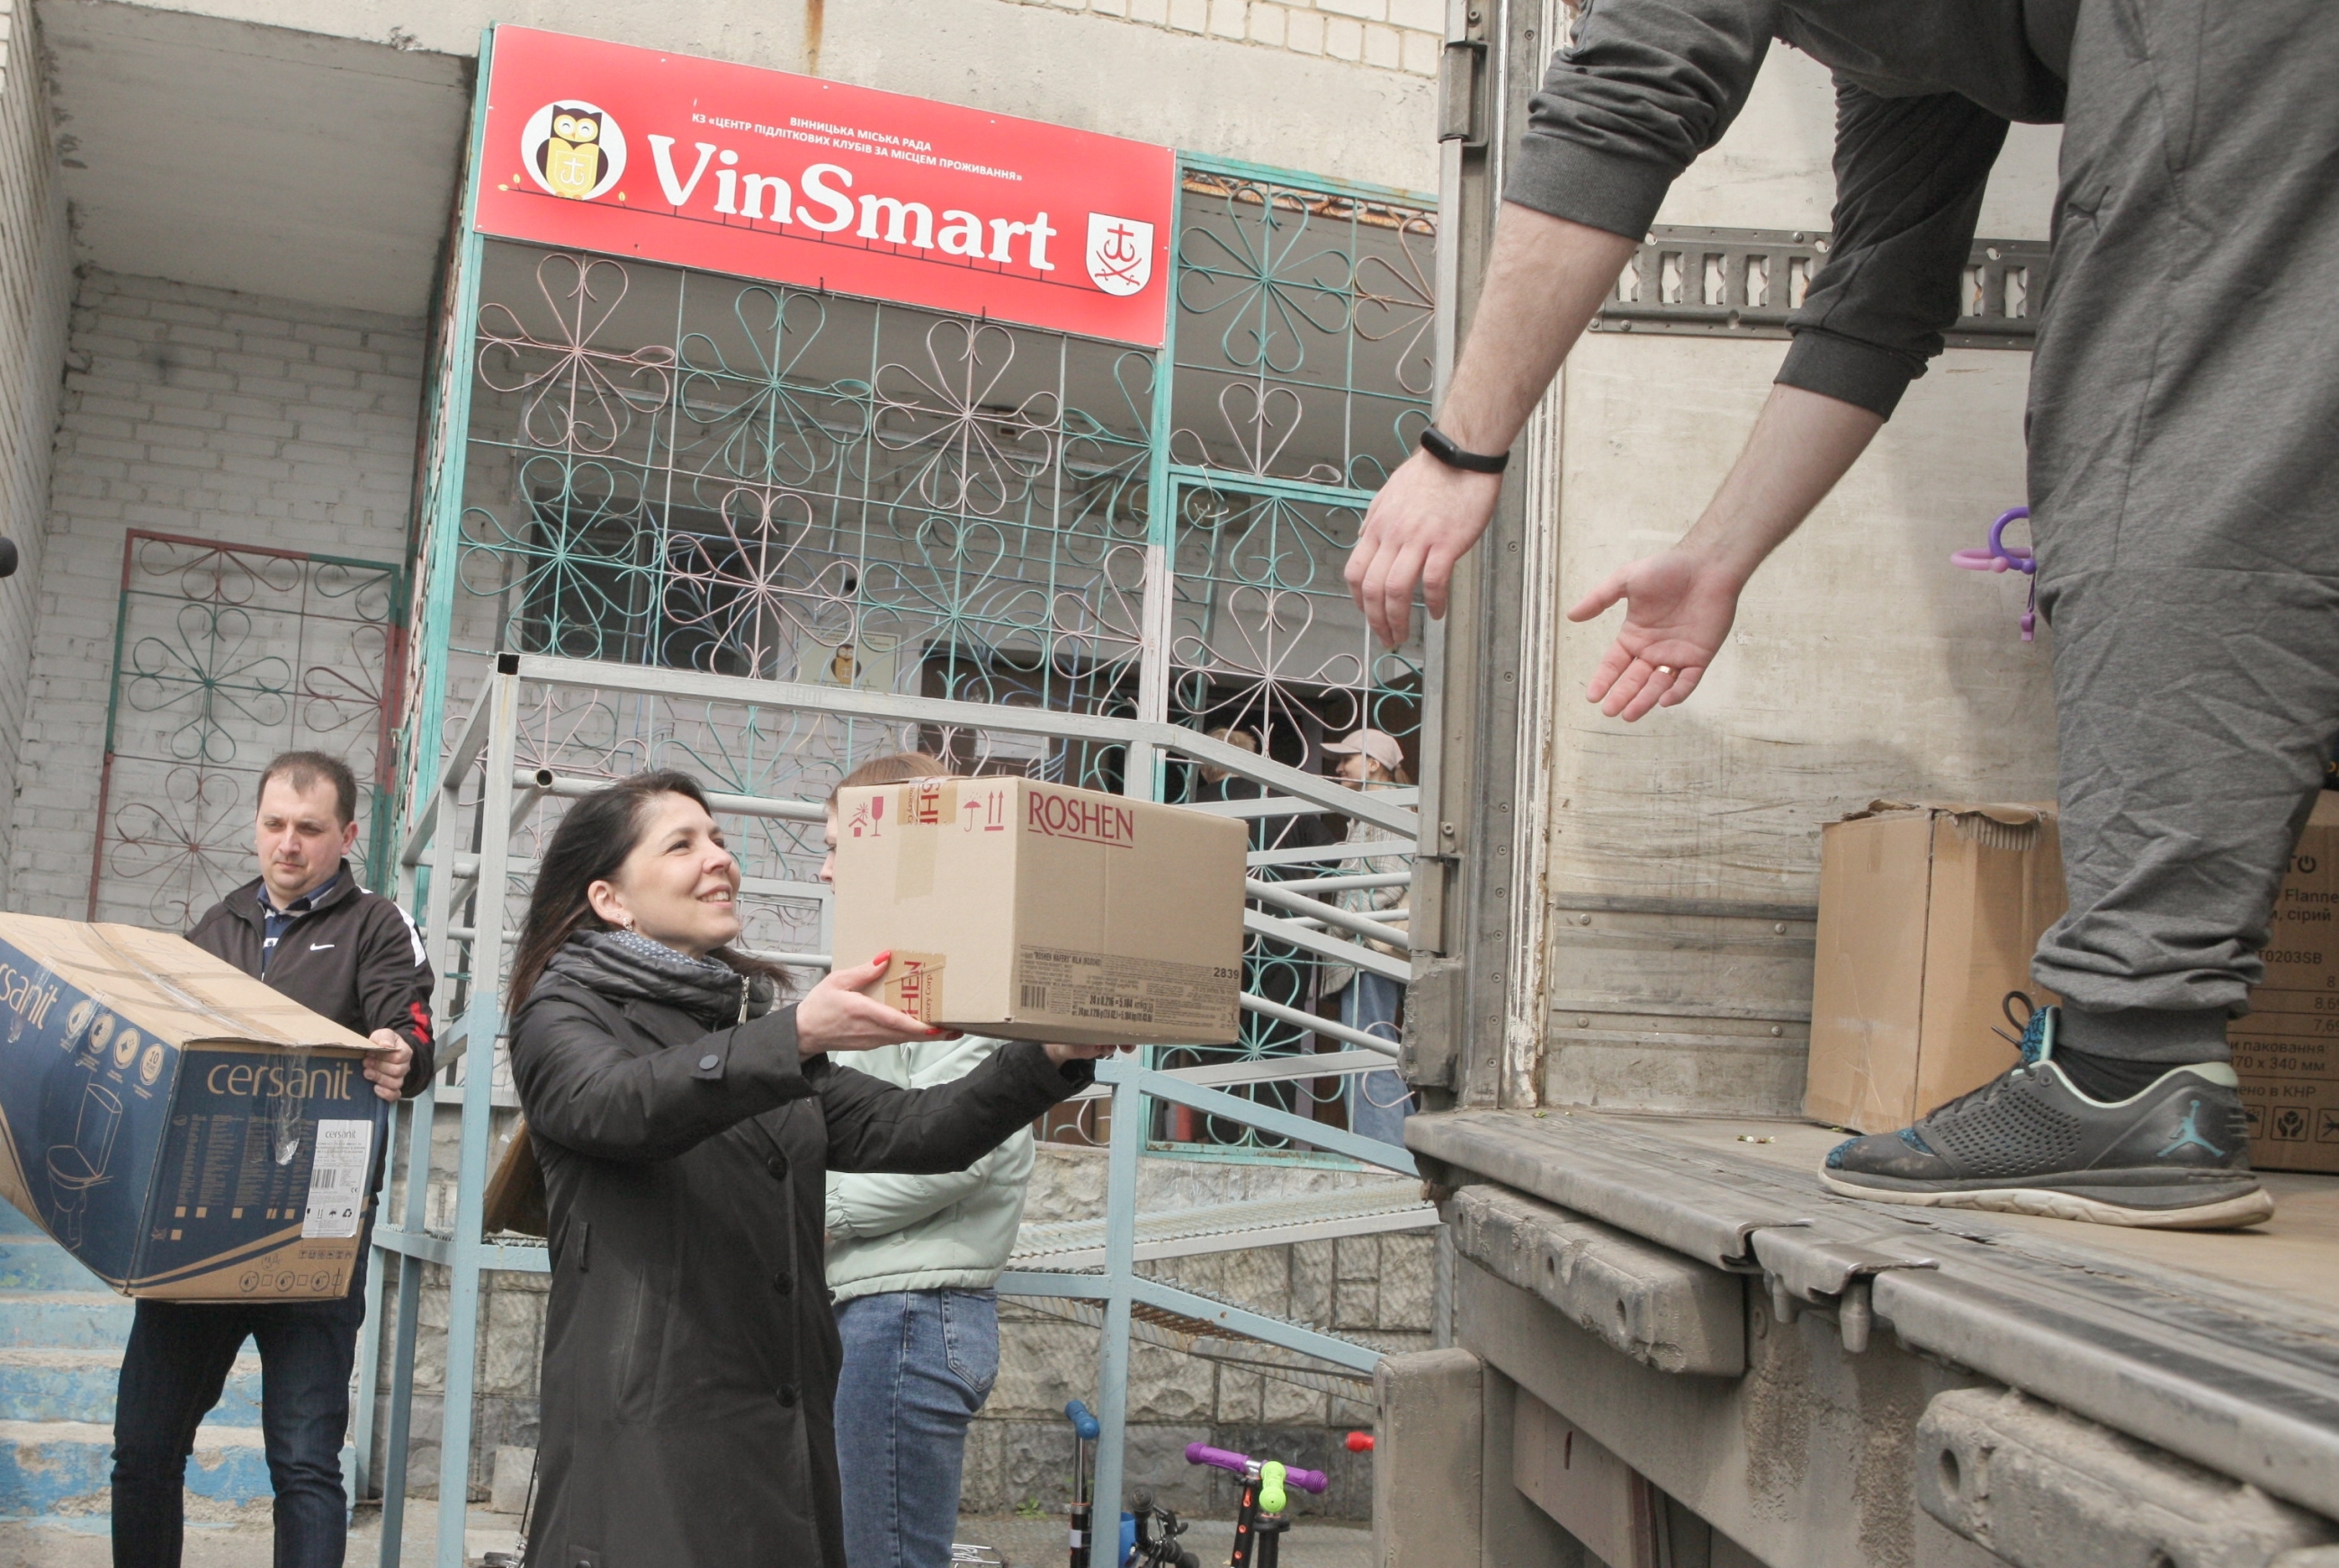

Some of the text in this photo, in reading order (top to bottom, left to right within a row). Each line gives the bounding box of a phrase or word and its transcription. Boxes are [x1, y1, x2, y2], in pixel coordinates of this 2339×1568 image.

[692, 112, 1023, 181] КЗ «ЦЕНТР ПІДЛІТКОВИХ КЛУБІВ ЗА МІСЦЕМ ПРОЖИВАННЯ»
[789, 117, 932, 151] ВІННИЦЬКА МІСЬКА РАДА
[647, 134, 1057, 271] VinSmart
[1028, 791, 1134, 841] ROSHEN
[2287, 908, 2332, 924] сірий
[1213, 967, 1240, 980] 2839
[901, 960, 922, 1021] HEN
[149, 1050, 159, 1064] 10
[2270, 1057, 2296, 1070] 340
[207, 1062, 354, 1100] cersanit
[2270, 1087, 2278, 1097] в
[2283, 1086, 2316, 1098] КНР
[325, 1129, 356, 1139] cersanit
